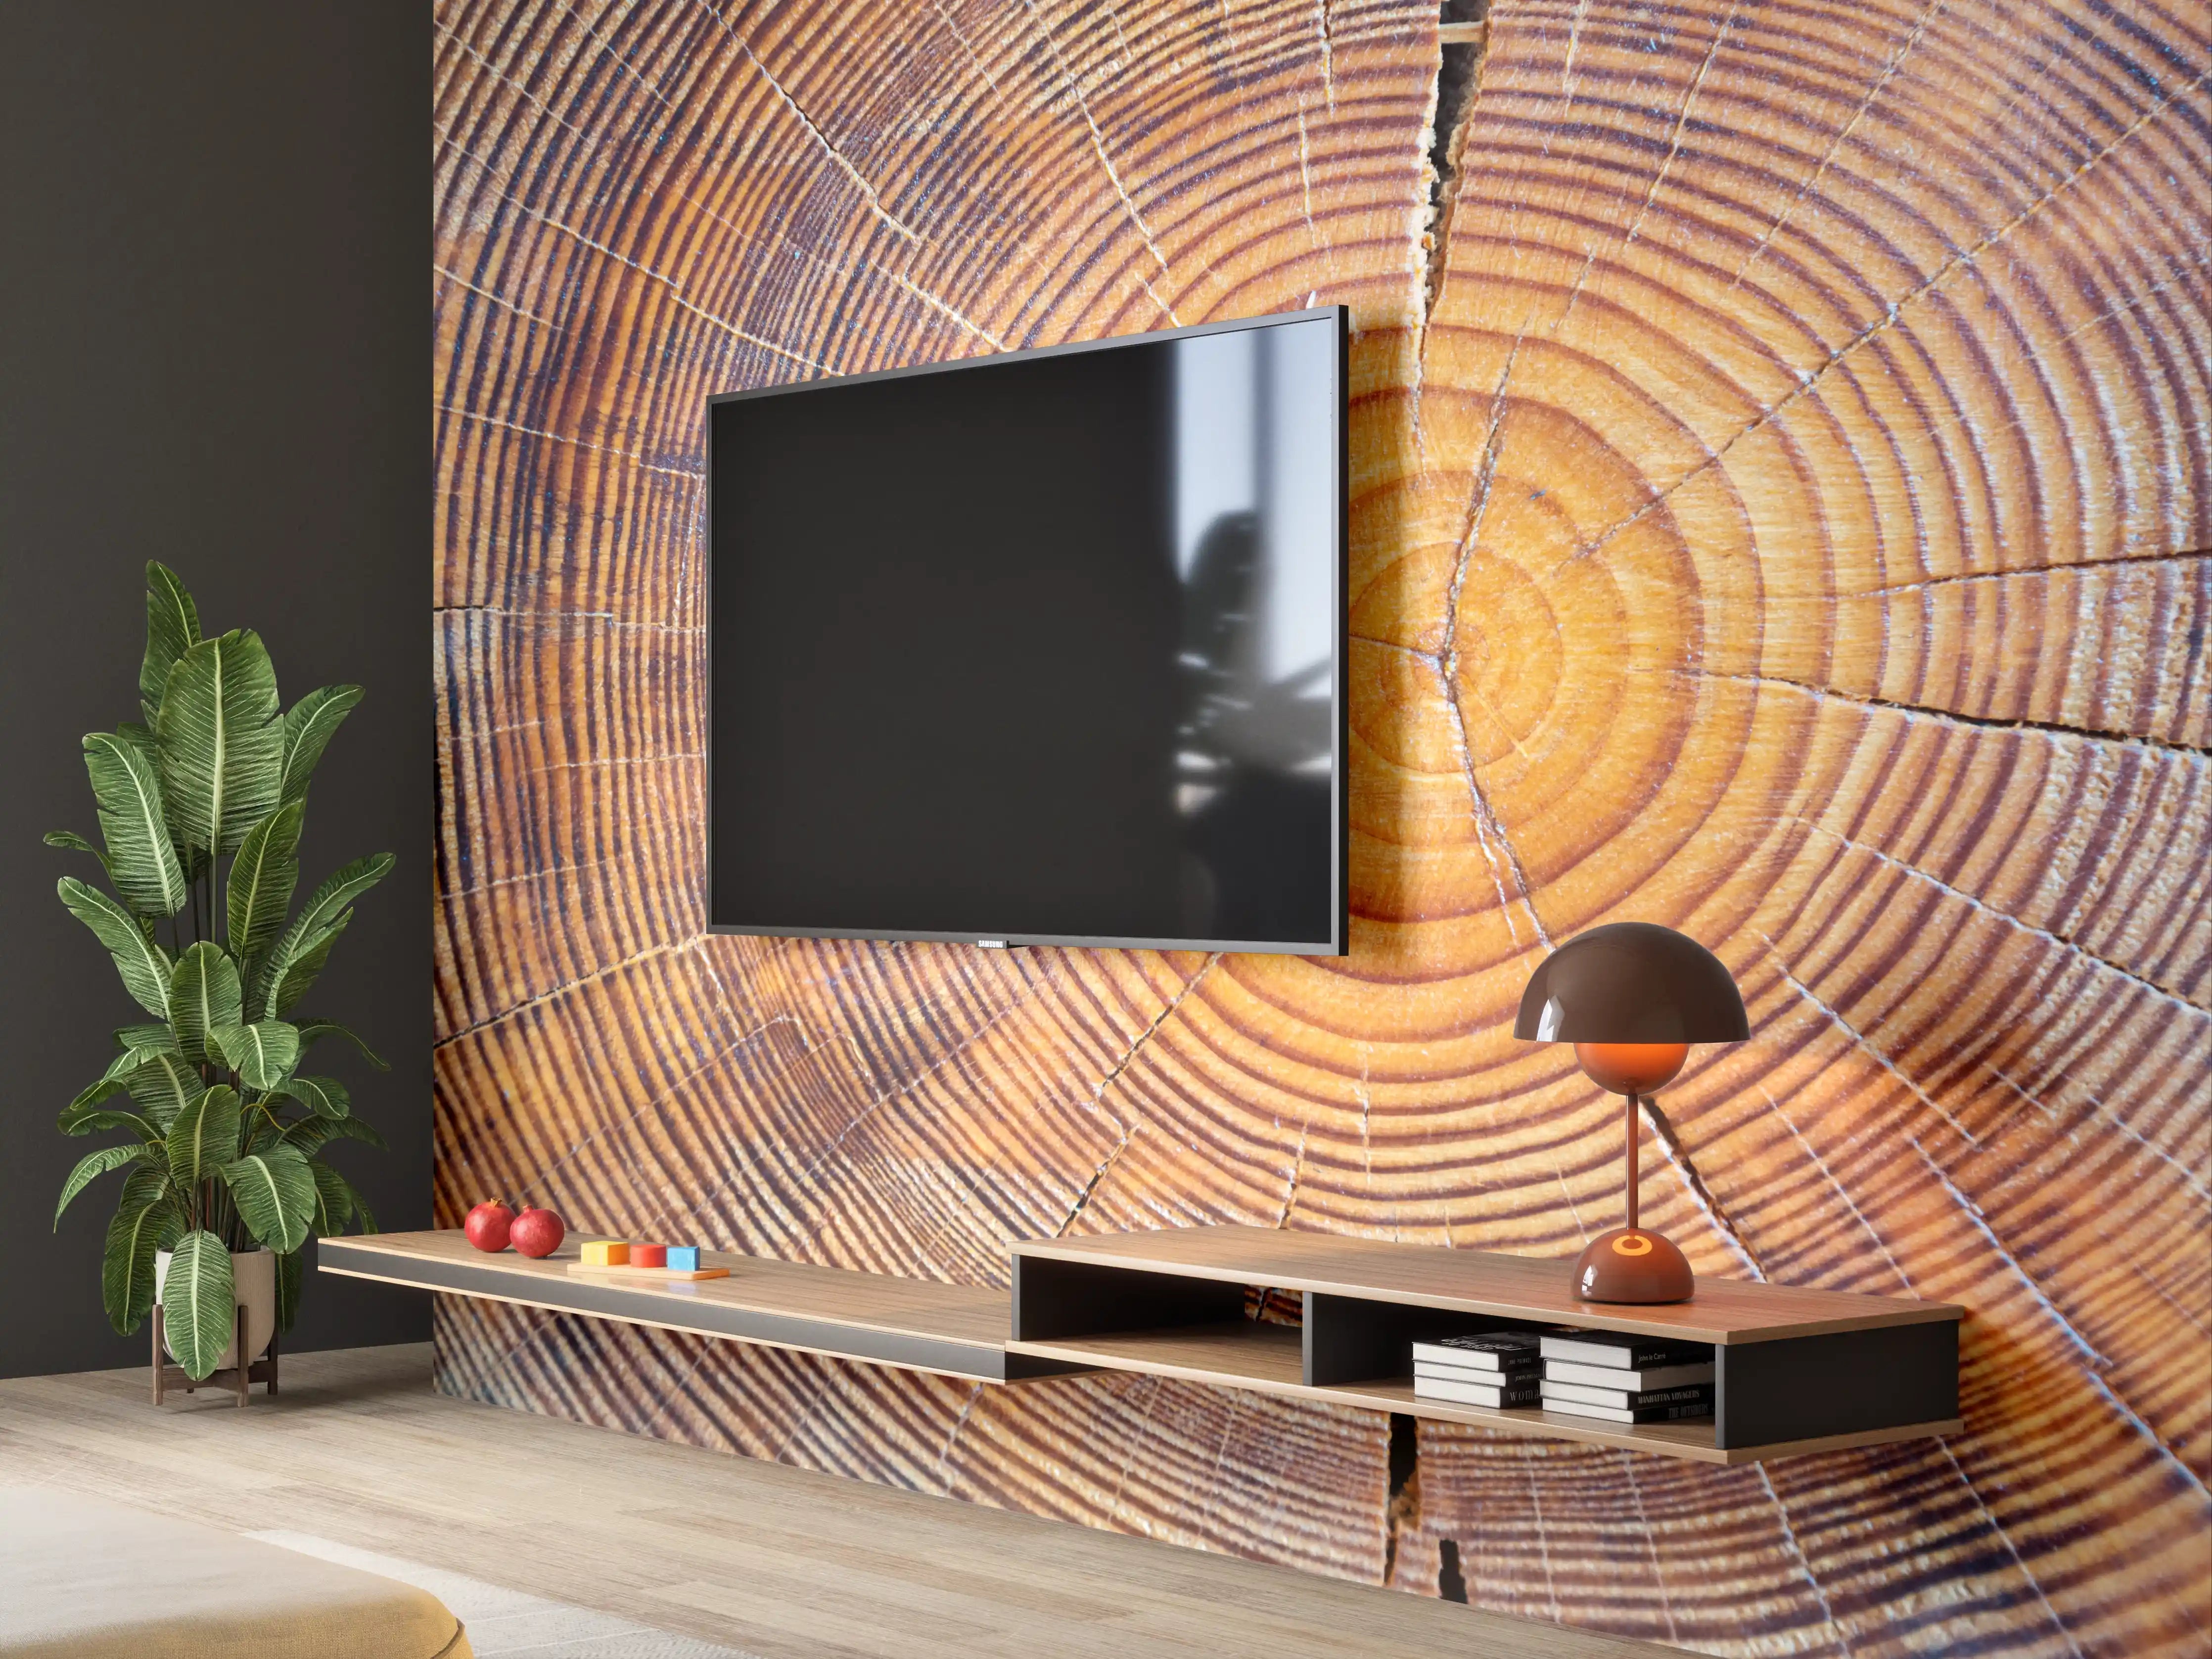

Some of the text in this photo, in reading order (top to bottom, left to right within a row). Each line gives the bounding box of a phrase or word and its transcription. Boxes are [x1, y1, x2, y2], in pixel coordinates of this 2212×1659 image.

[1638, 1354, 1648, 1363] John
[1510, 1389, 1539, 1401] woma
[1638, 1390, 1700, 1404] MANHATTAN VOYAGERS
